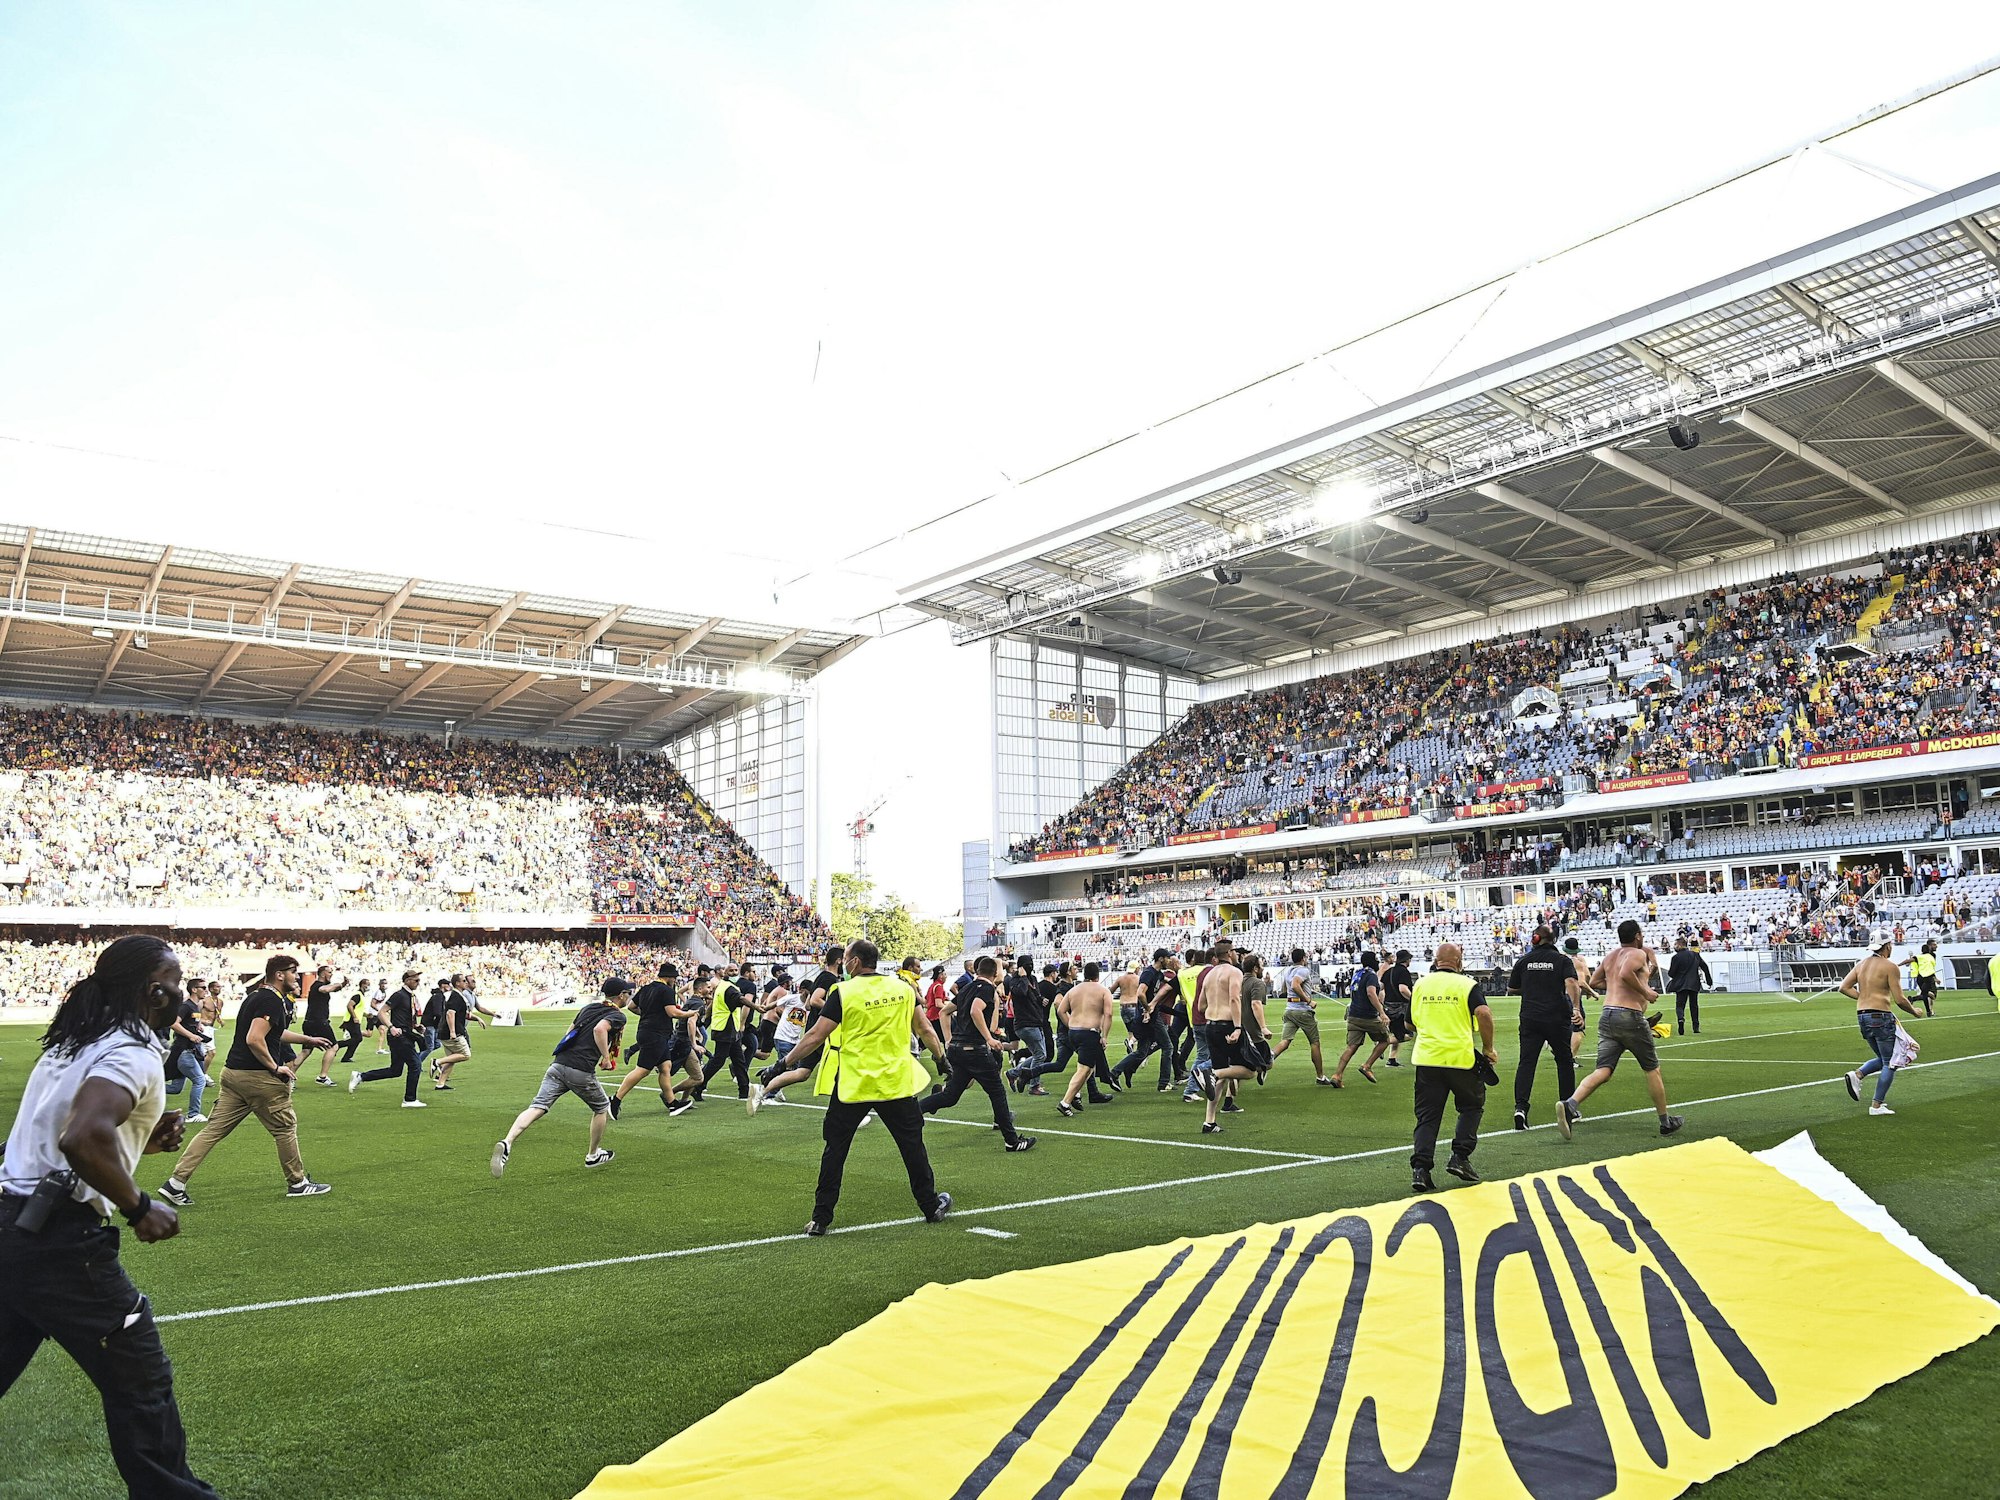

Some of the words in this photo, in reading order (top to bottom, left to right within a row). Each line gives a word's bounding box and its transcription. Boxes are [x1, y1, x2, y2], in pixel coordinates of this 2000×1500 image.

[1810, 755, 1842, 766] GROUPE
[1845, 747, 1903, 762] LEMPEREUR
[1503, 782, 1537, 794] Auchan
[1611, 779, 1653, 790] AUSHOPPING
[1654, 774, 1685, 784] NOYELLES
[1373, 807, 1401, 820] WINAMAX
[865, 995, 904, 1007] AGORA
